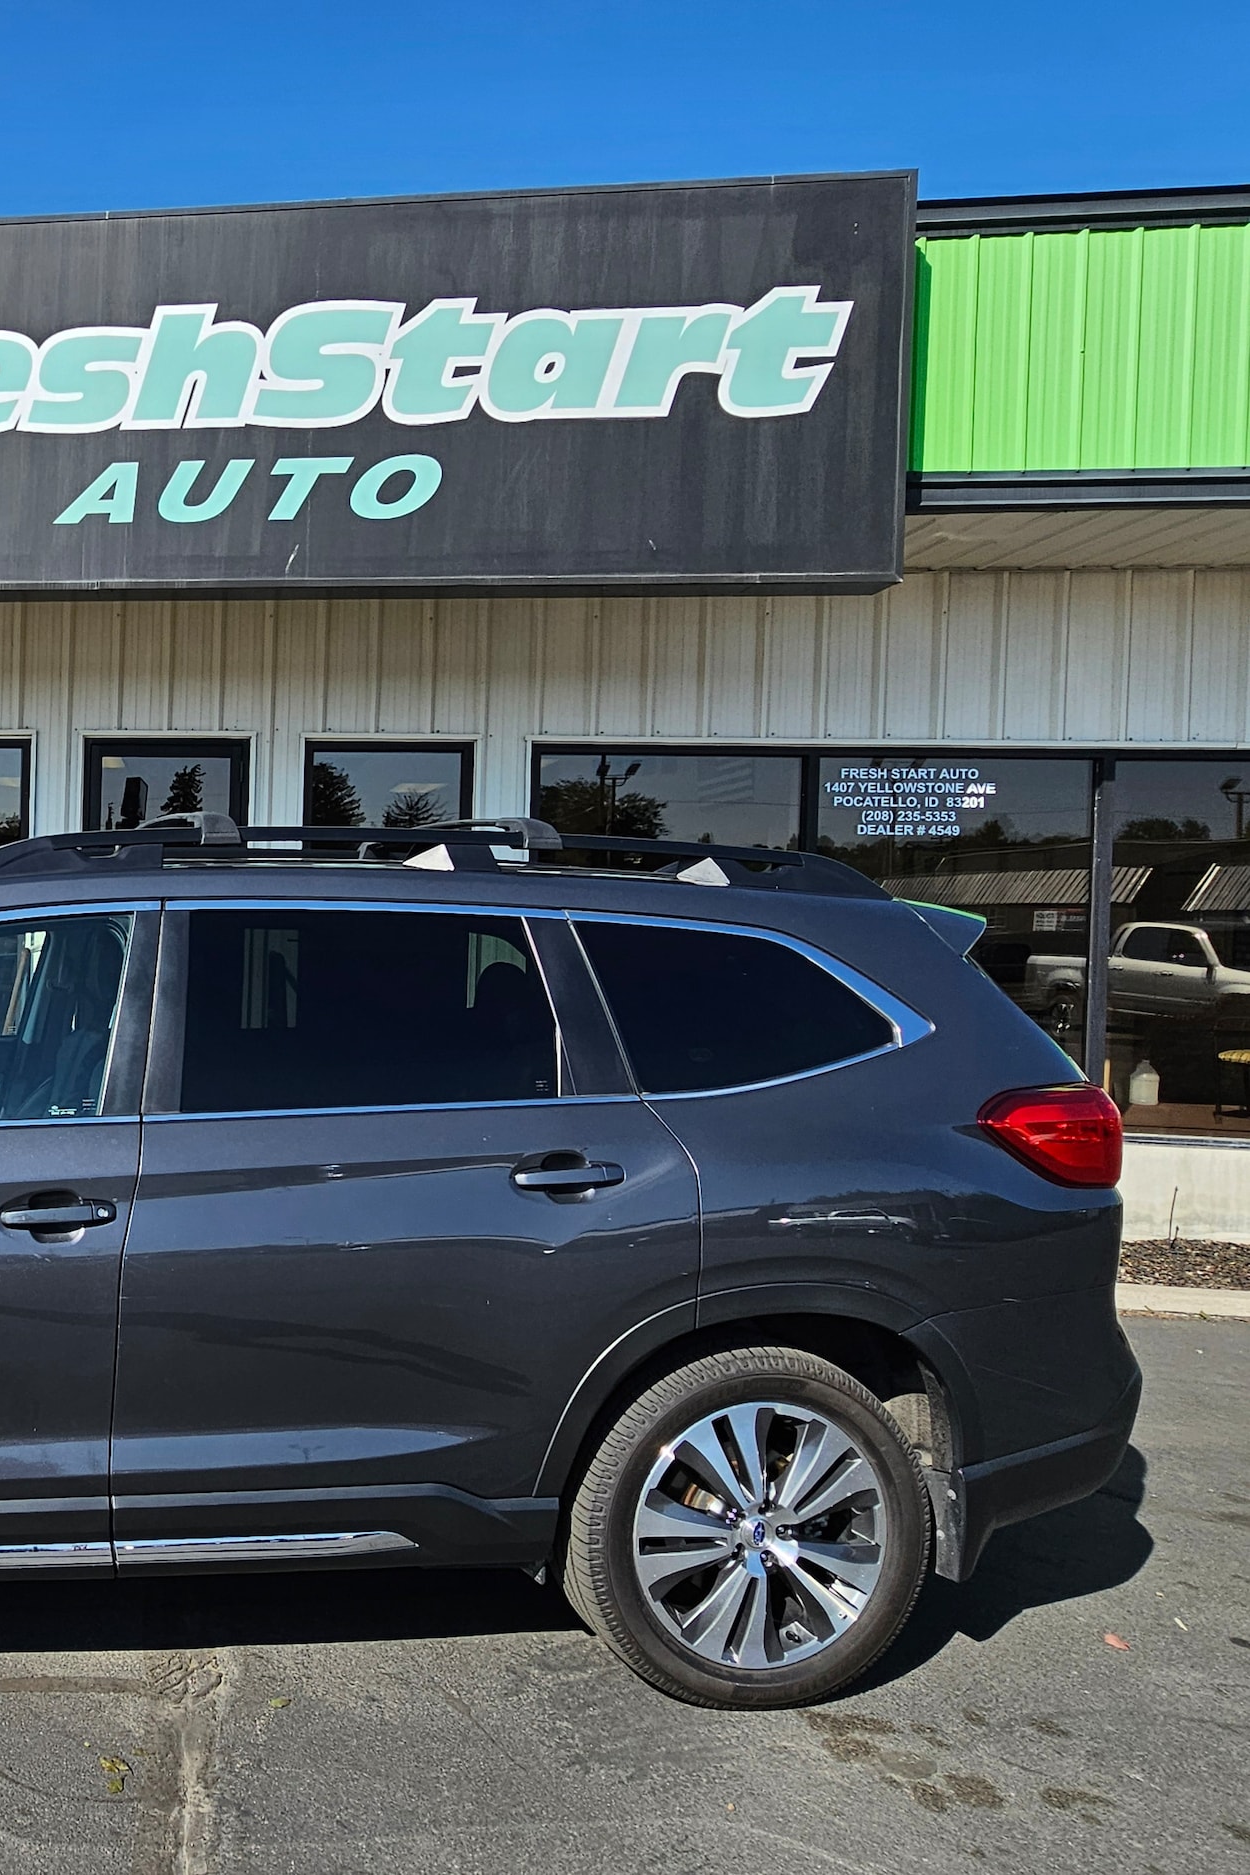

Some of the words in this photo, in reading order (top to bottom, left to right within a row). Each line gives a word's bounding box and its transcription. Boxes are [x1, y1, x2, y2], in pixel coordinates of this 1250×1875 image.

[53, 453, 443, 525] AUTO
[841, 768, 887, 779] FRESH
[891, 768, 937, 779] START
[939, 768, 979, 779] AUTO
[824, 782, 855, 793] 1407
[858, 782, 965, 793] YELLOWSTONE
[966, 783, 997, 794] AVE
[833, 796, 921, 809] POCATELLO,
[924, 796, 939, 807] ID
[946, 796, 985, 808] 83201
[862, 811, 894, 823] (208)
[897, 811, 957, 821] 235-5353
[857, 825, 914, 835] DEALER
[916, 825, 926, 835] #
[928, 825, 961, 836] 4549
